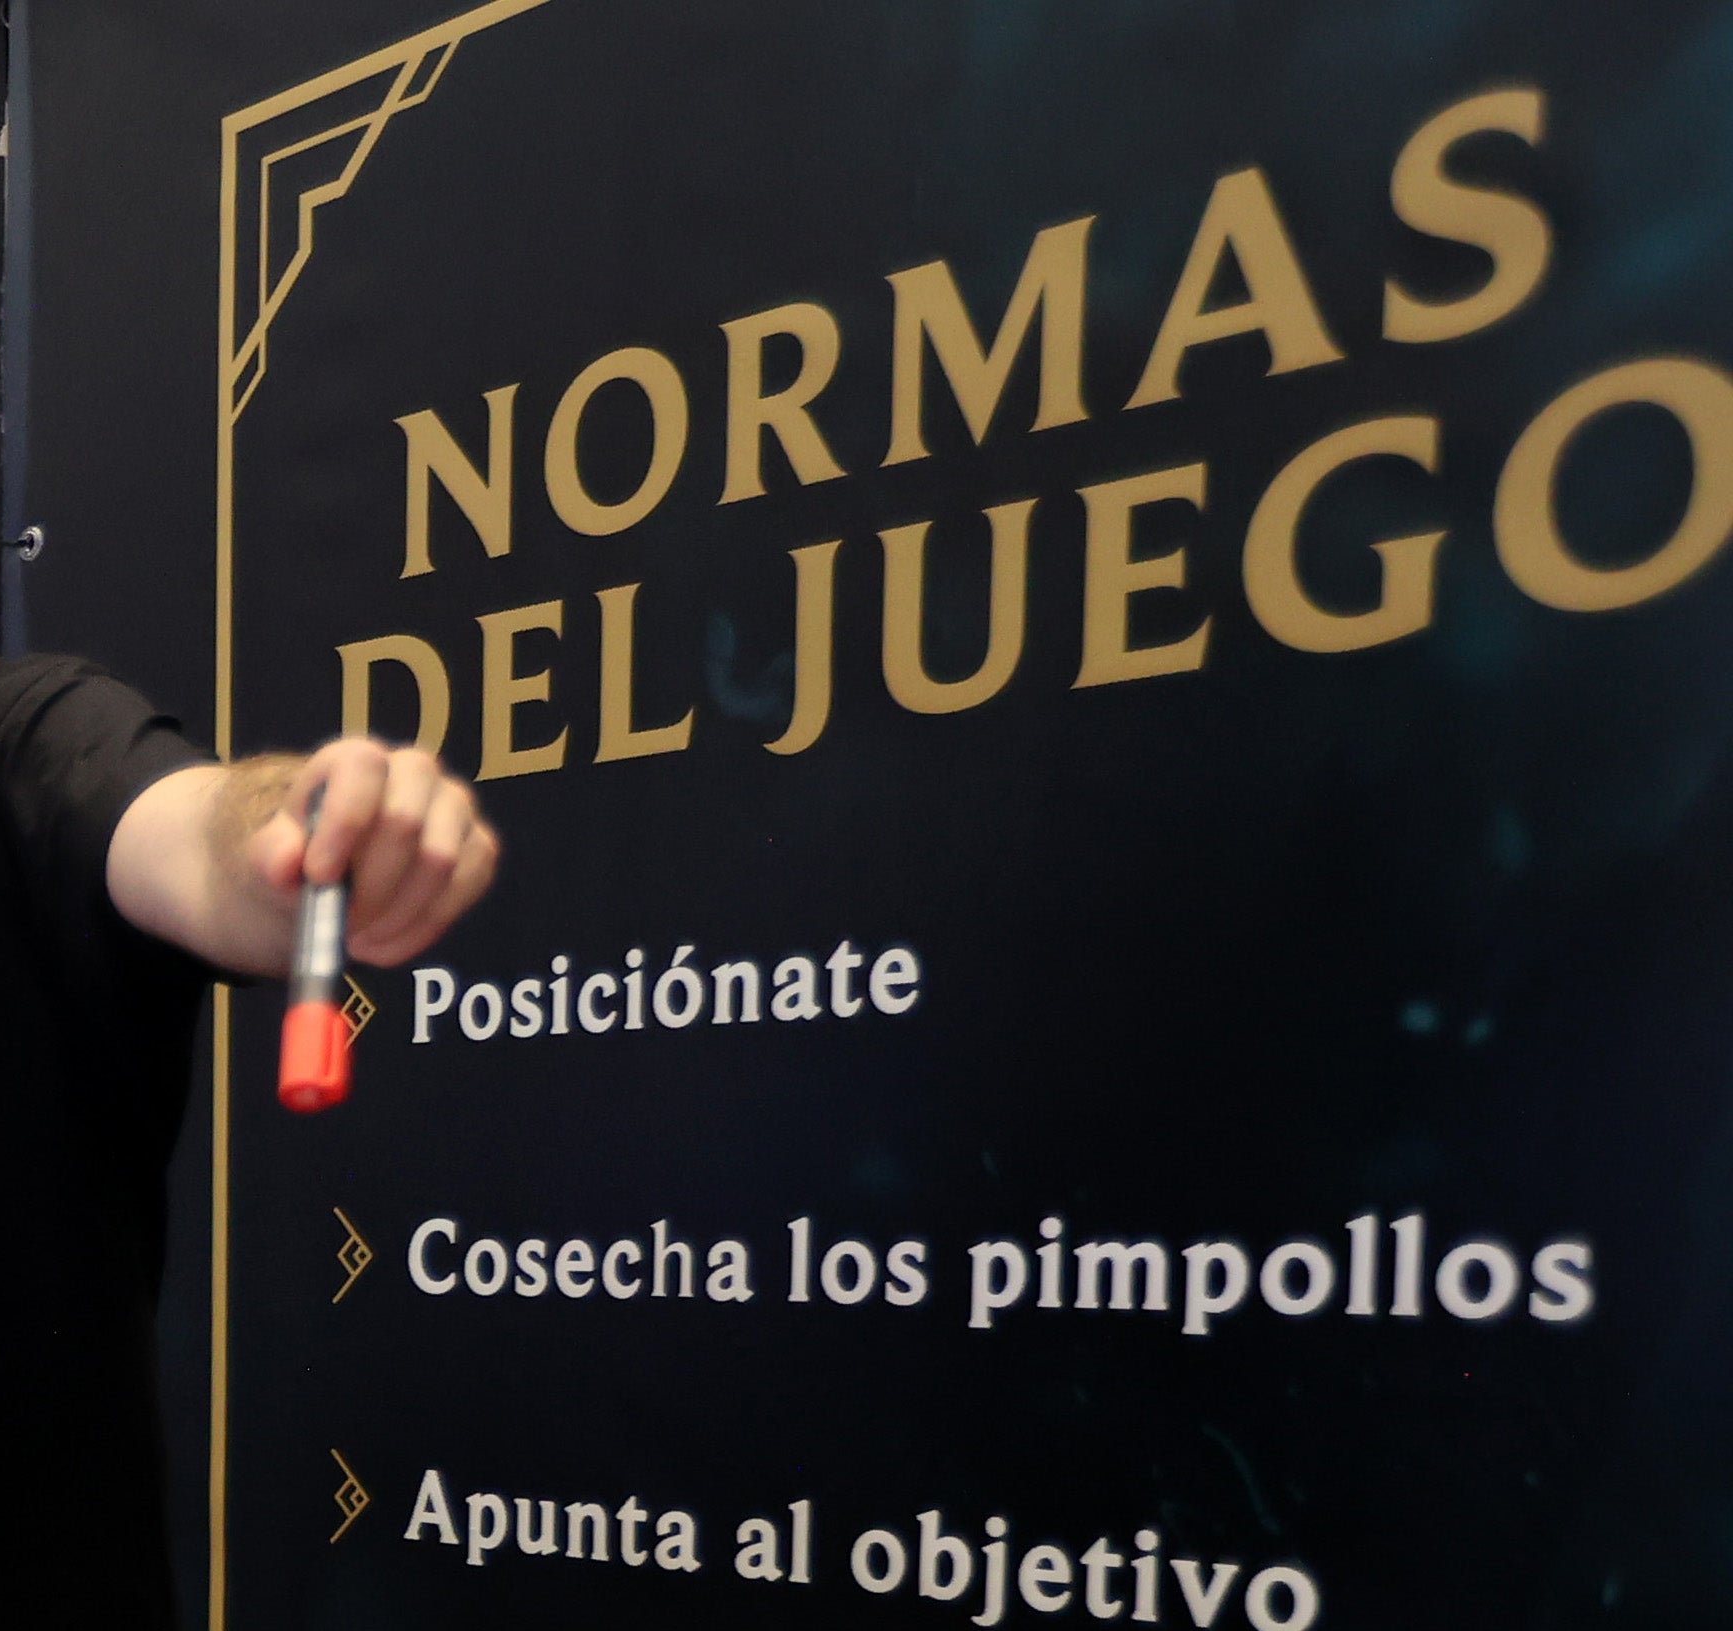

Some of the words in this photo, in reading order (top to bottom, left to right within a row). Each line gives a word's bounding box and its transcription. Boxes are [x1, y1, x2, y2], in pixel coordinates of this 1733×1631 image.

[393, 84, 1555, 582] NORMAS
[335, 582, 696, 786] DEL
[762, 354, 1733, 757] JUEGO
[410, 939, 922, 1045] Posiciónate
[406, 1216, 755, 1303] Cosecha
[786, 1216, 930, 1307] los
[967, 1211, 1596, 1336] pimpollos
[403, 1468, 703, 1575] Apunta
[734, 1498, 814, 1587] al
